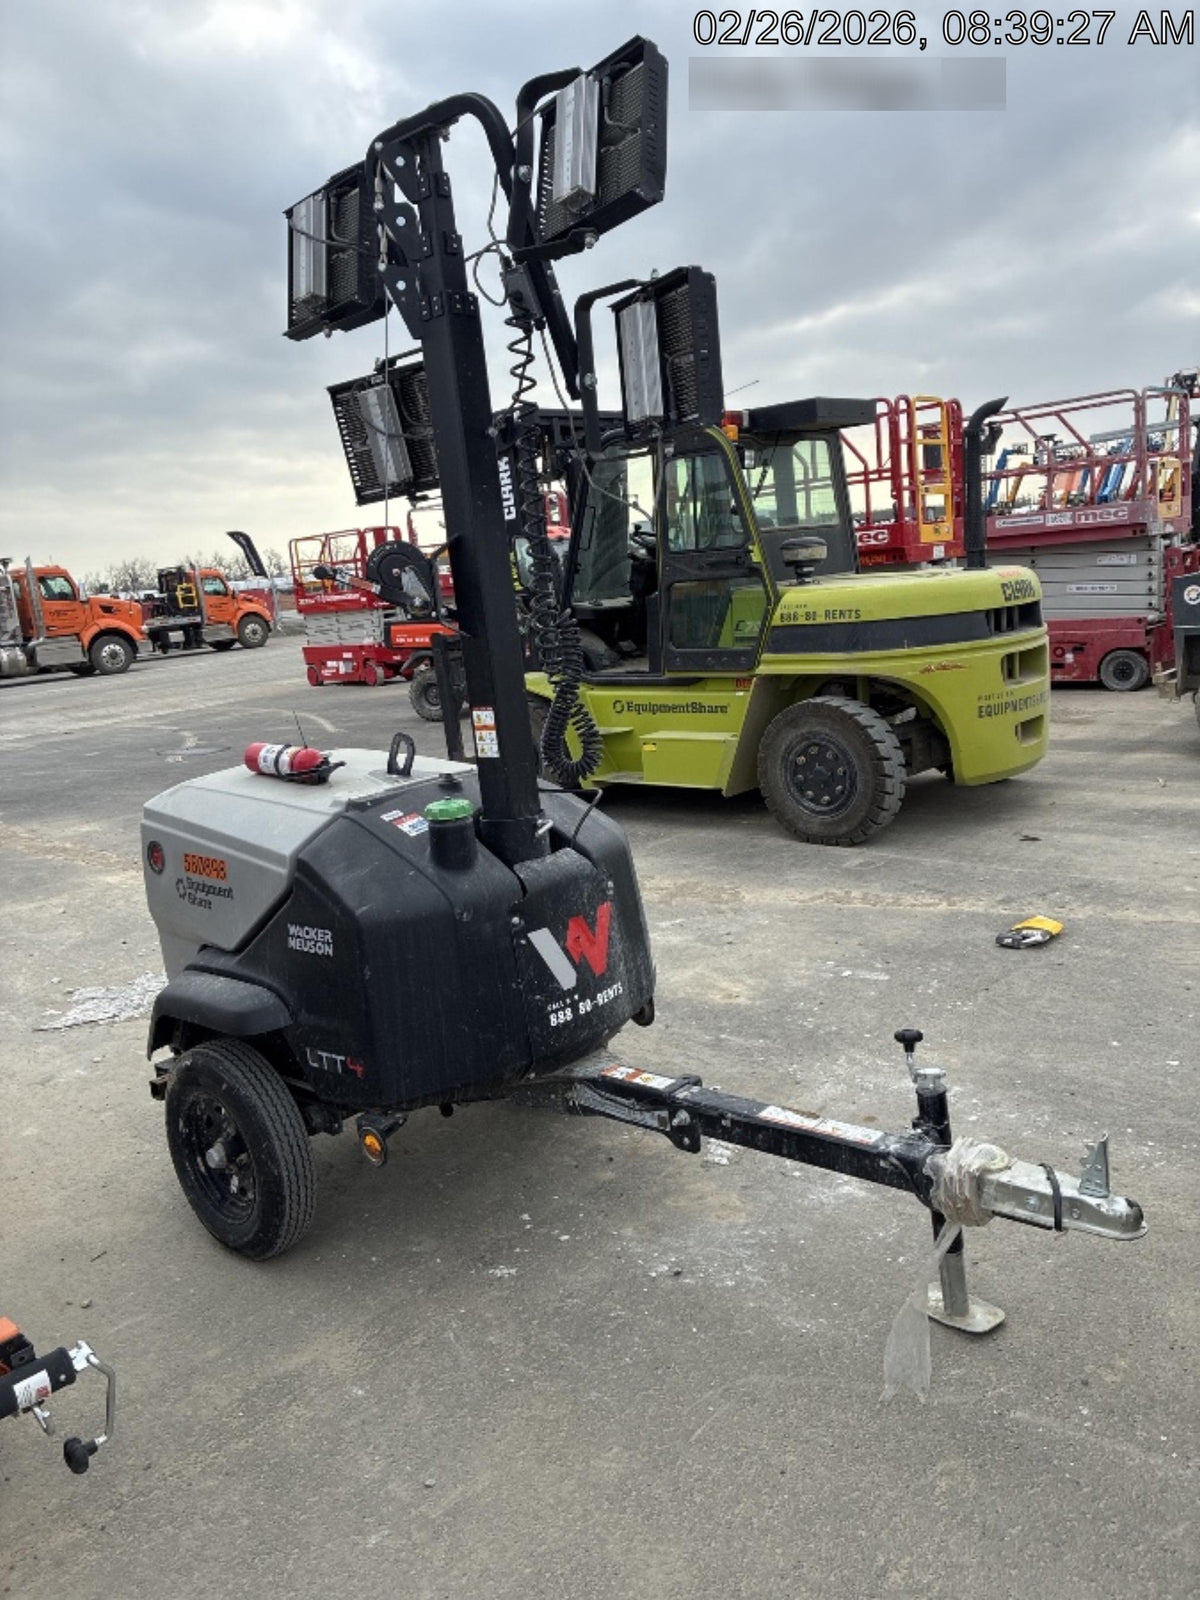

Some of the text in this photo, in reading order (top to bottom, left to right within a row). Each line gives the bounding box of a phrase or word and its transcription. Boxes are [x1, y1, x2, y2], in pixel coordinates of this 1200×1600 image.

[497, 455, 517, 521] CLARK
[1075, 506, 1129, 524] mec
[855, 529, 889, 546] ec
[626, 700, 728, 715] EquipmentShare
[287, 924, 334, 943] WACKER
[287, 937, 334, 957] NEUSON
[304, 1046, 366, 1080] LTT4
